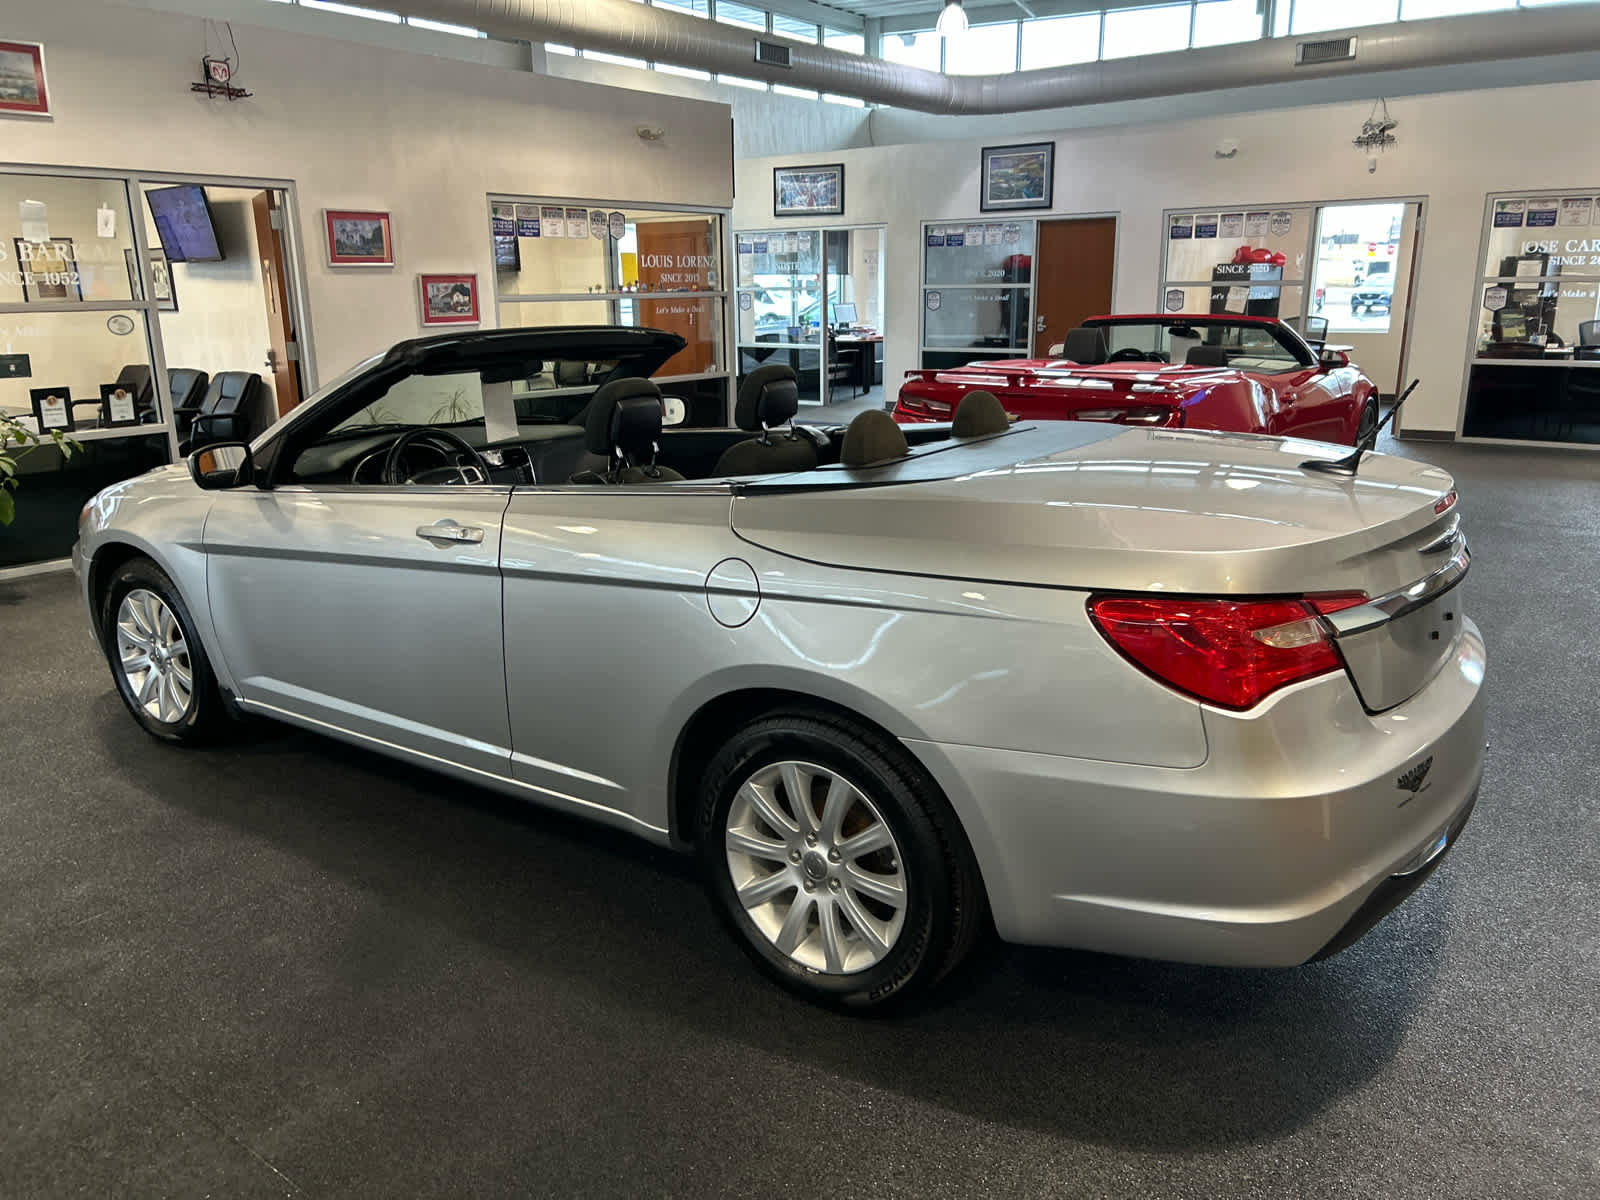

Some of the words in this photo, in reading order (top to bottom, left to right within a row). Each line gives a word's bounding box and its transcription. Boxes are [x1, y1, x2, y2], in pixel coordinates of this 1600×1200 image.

[641, 254, 673, 268] LOUIS
[1547, 255, 1585, 266] SINCE
[1216, 264, 1244, 275] SINCE
[44, 272, 80, 285] 1952
[660, 272, 682, 283] SINCE
